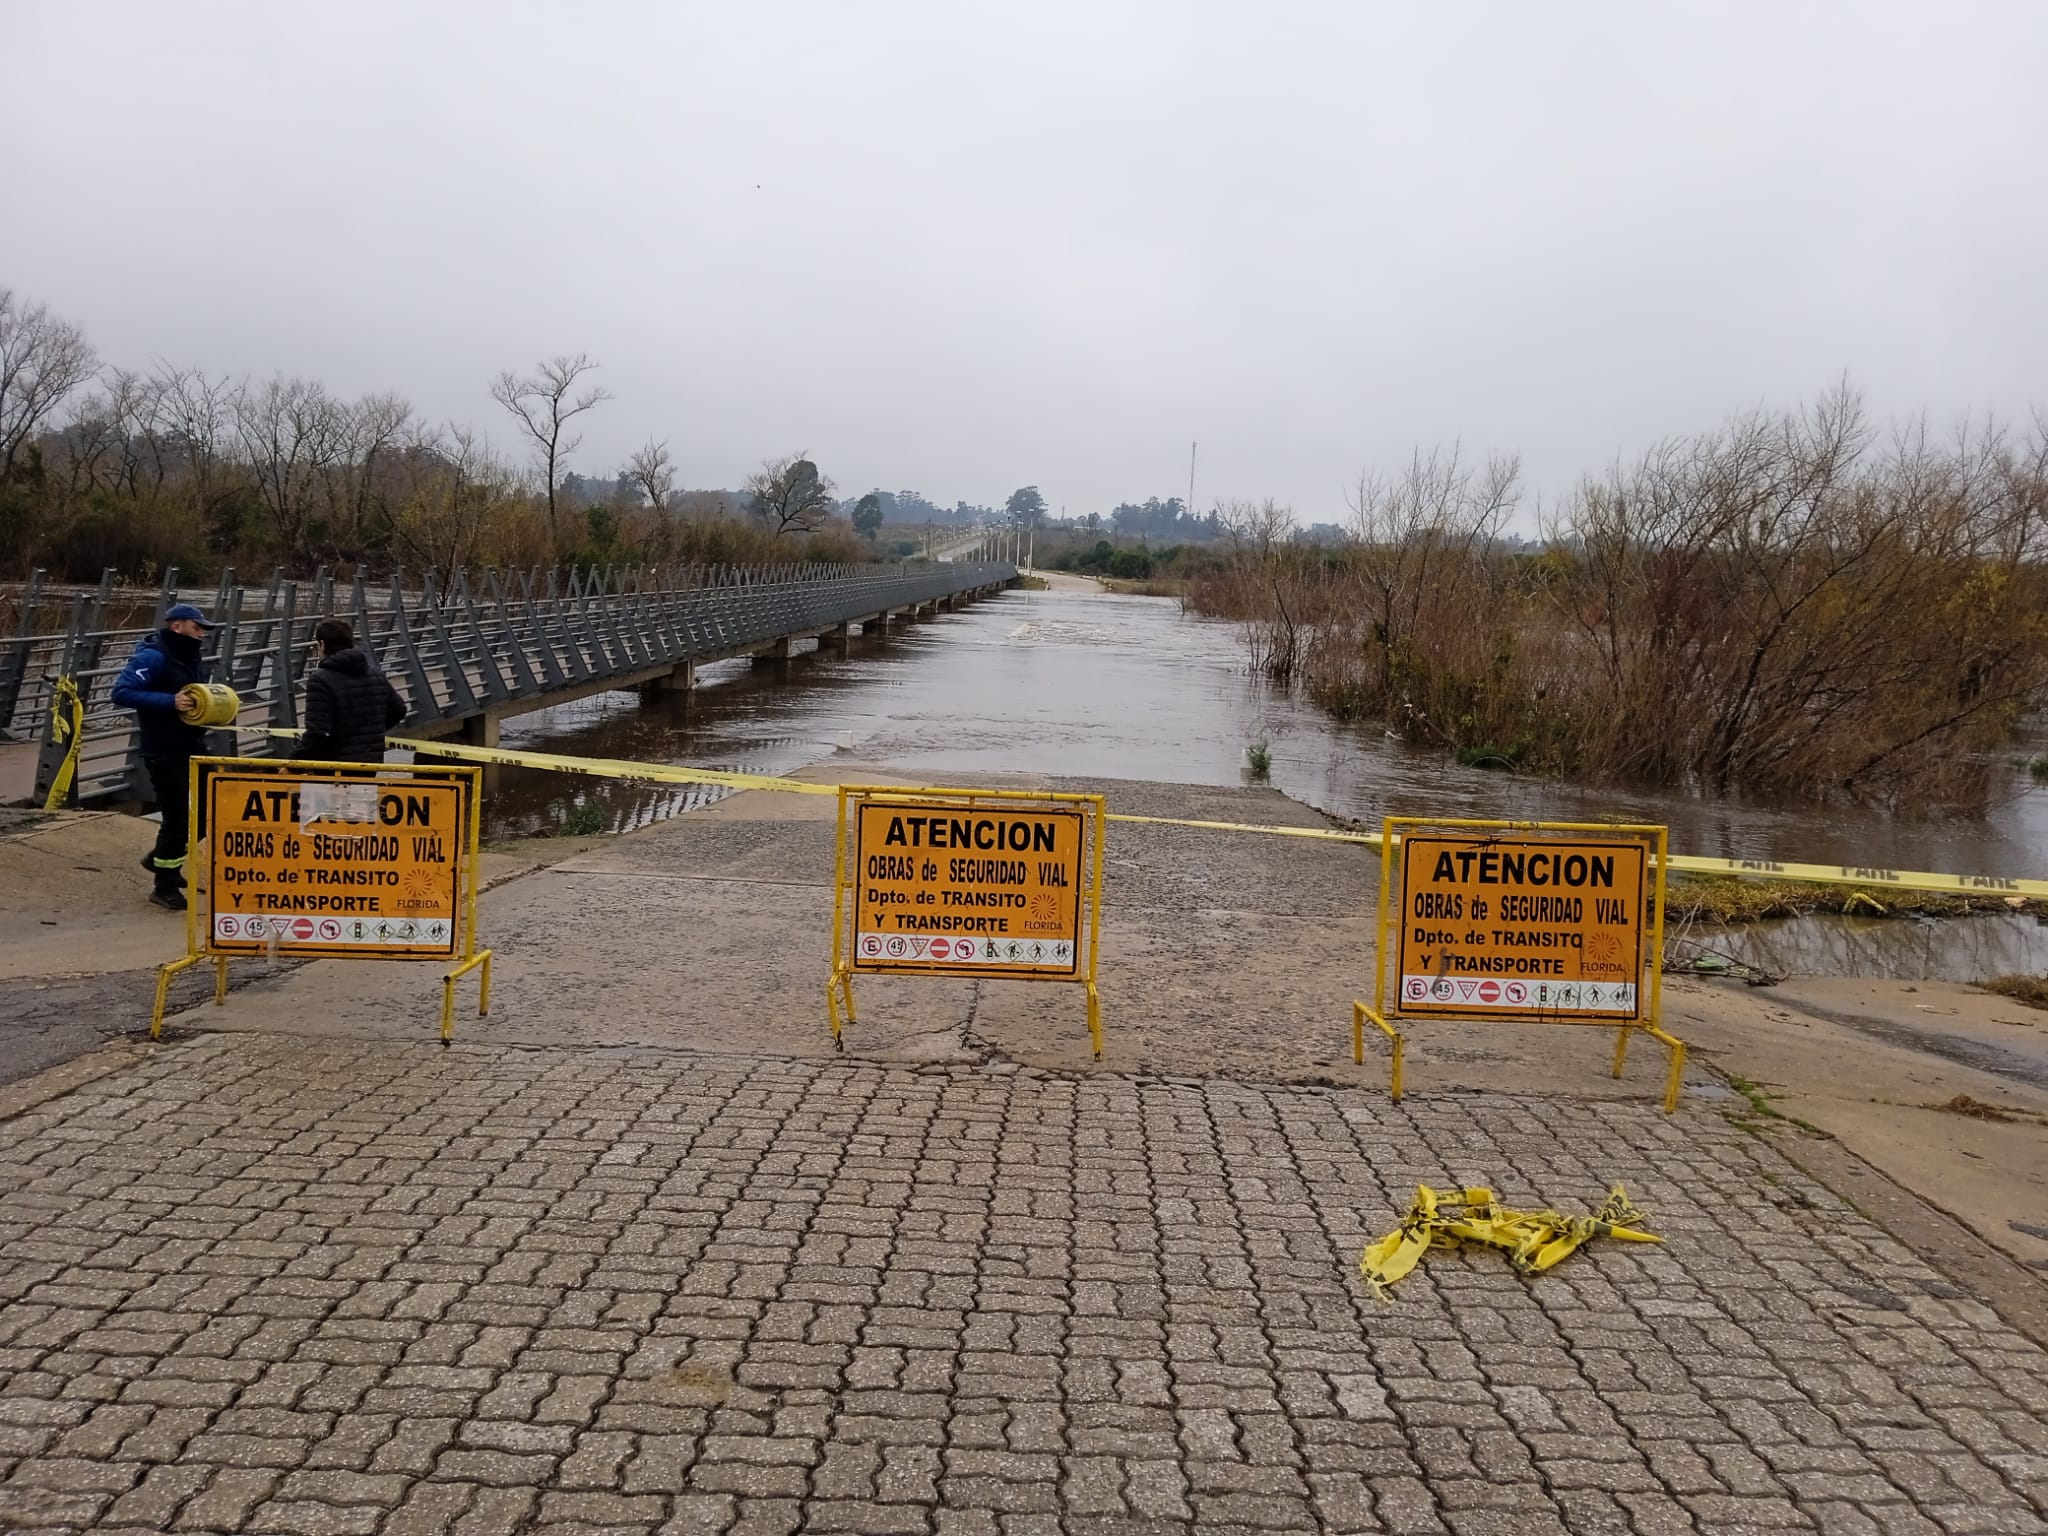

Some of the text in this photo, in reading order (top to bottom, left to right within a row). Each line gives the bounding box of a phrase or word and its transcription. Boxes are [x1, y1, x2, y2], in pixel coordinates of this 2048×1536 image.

[885, 816, 1056, 852] ATENCION
[224, 832, 445, 863] OBRAS de SEGURIDAD VIAL
[224, 867, 399, 886] Dpto. de TRANSITO
[868, 855, 1068, 887] OBRAS de SEGURIDAD VIAL
[1432, 851, 1614, 887] ATENCION
[231, 893, 380, 912] Y TRANSPORTE
[397, 899, 439, 910] FLORIDA
[868, 888, 1027, 908] Dpto. de TRANSITO
[1414, 892, 1628, 925] OBRAS de SEGURIDAD VIAL
[224, 920, 233, 933] E
[249, 922, 263, 931] 45
[874, 914, 1009, 932] Y TRANSPORTE
[1024, 920, 1063, 931] FLORIDA
[867, 940, 876, 952] E
[890, 941, 902, 950] 45
[1414, 928, 1583, 949] Dpto. de TRANSITO
[1420, 955, 1565, 974] Y TRANSPORTE
[1581, 961, 1623, 974] FLORIDA
[1412, 983, 1422, 996] E
[1437, 984, 1450, 993] 45
